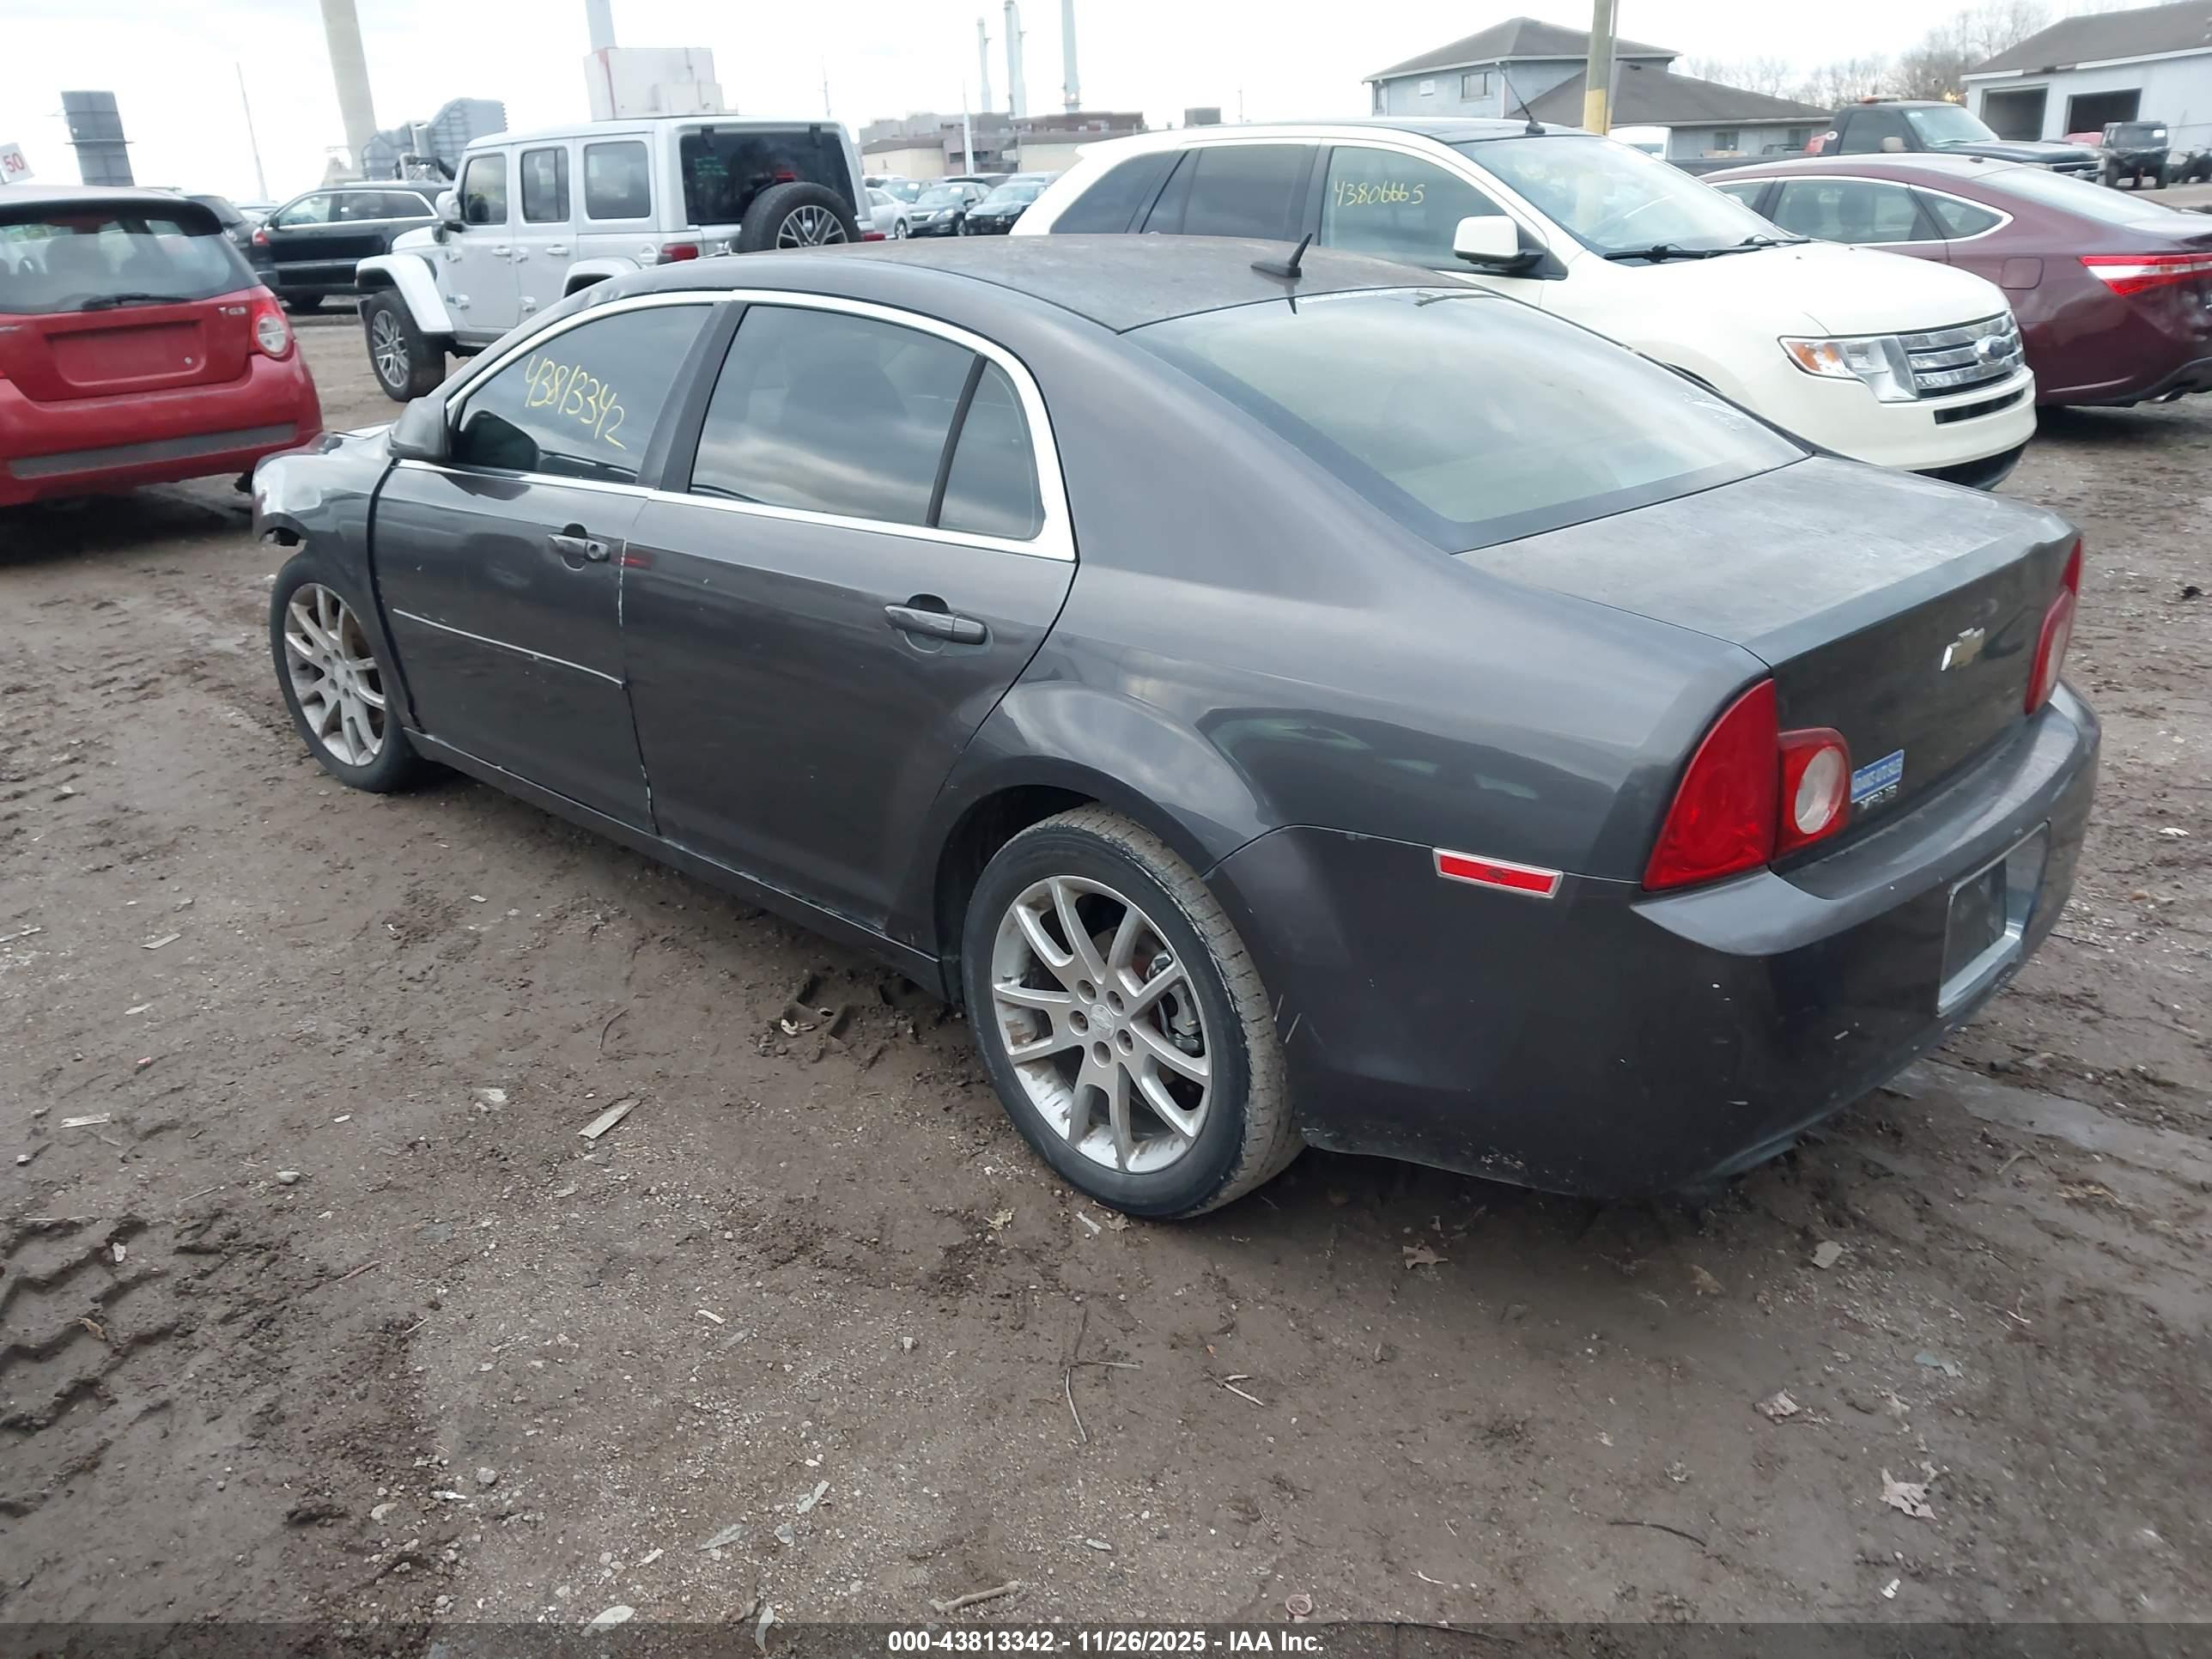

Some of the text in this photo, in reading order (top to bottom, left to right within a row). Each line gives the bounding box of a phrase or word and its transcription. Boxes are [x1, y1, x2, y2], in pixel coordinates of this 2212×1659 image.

[3, 152, 25, 173] 50
[1334, 180, 1425, 206] 43806665
[525, 354, 628, 450] 43813342
